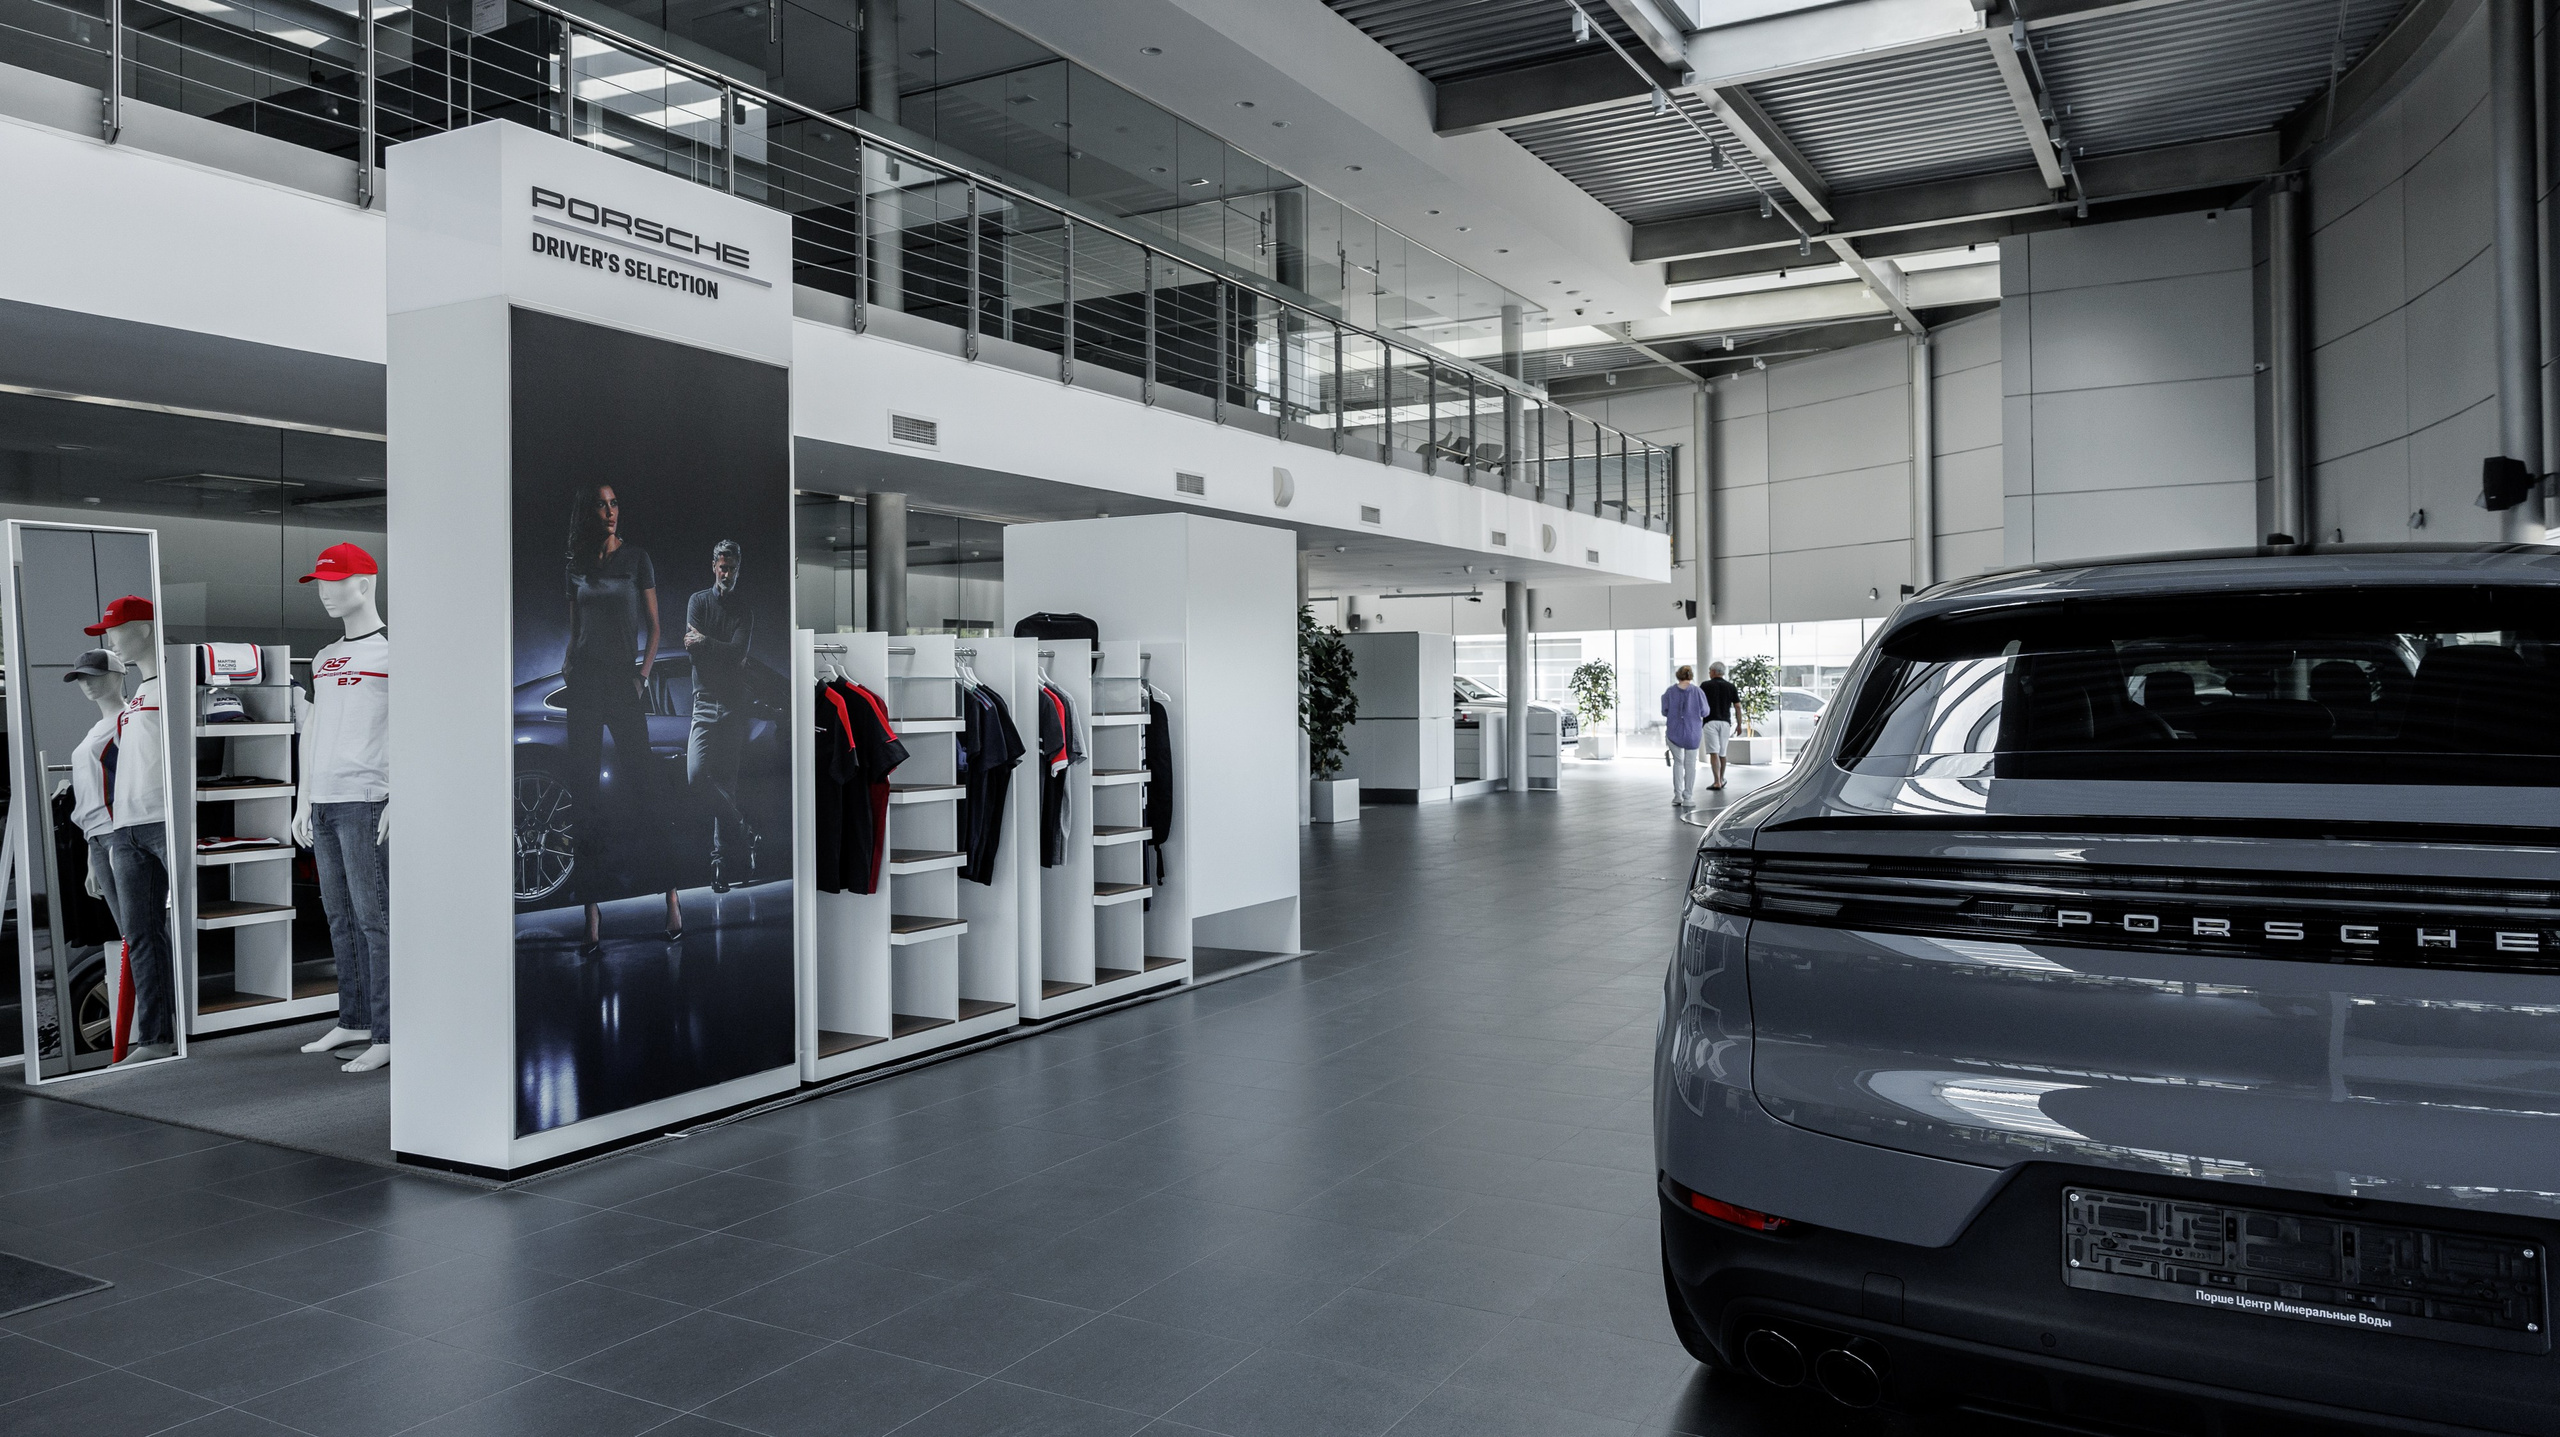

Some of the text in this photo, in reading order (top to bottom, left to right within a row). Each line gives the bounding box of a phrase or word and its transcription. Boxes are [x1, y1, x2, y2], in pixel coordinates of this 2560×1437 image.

[532, 186, 749, 269] PORSCHE
[532, 232, 718, 300] DRIVER'S SELECTION
[338, 677, 362, 686] 2.7
[2057, 909, 2539, 953] PORSCHE
[2195, 1289, 2392, 1328] Порше Центр Минеральные Воды
